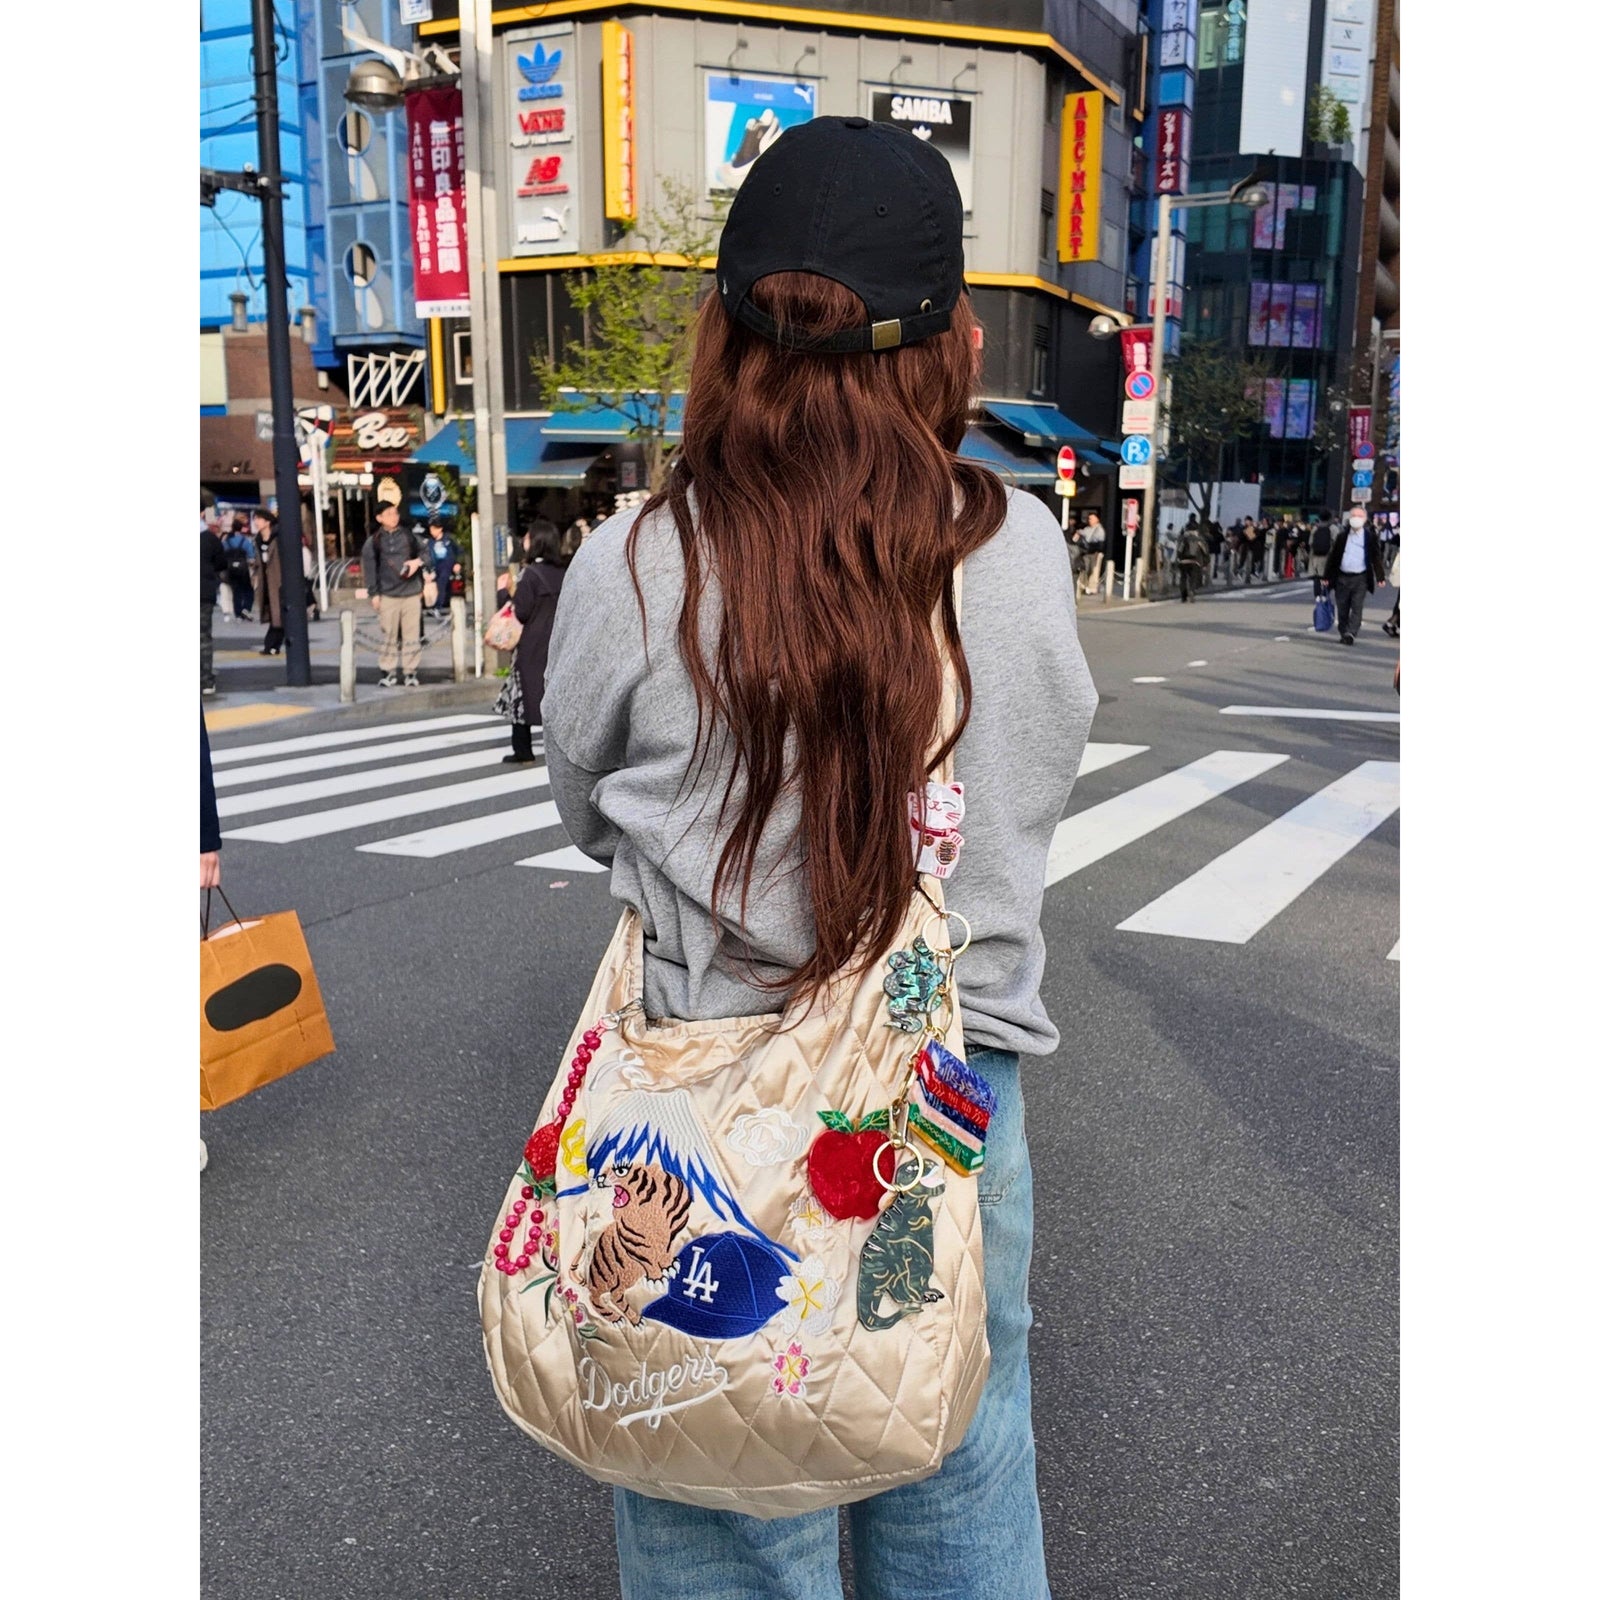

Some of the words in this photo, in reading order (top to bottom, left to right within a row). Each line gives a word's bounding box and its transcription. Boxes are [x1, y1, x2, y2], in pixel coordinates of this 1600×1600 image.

[518, 108, 565, 135] VANS
[890, 97, 953, 125] SAMBA
[429, 120, 461, 274] 無印良品週間
[352, 412, 410, 449] Bee
[682, 1245, 720, 1303] LA
[577, 1344, 729, 1431] Dodgers
